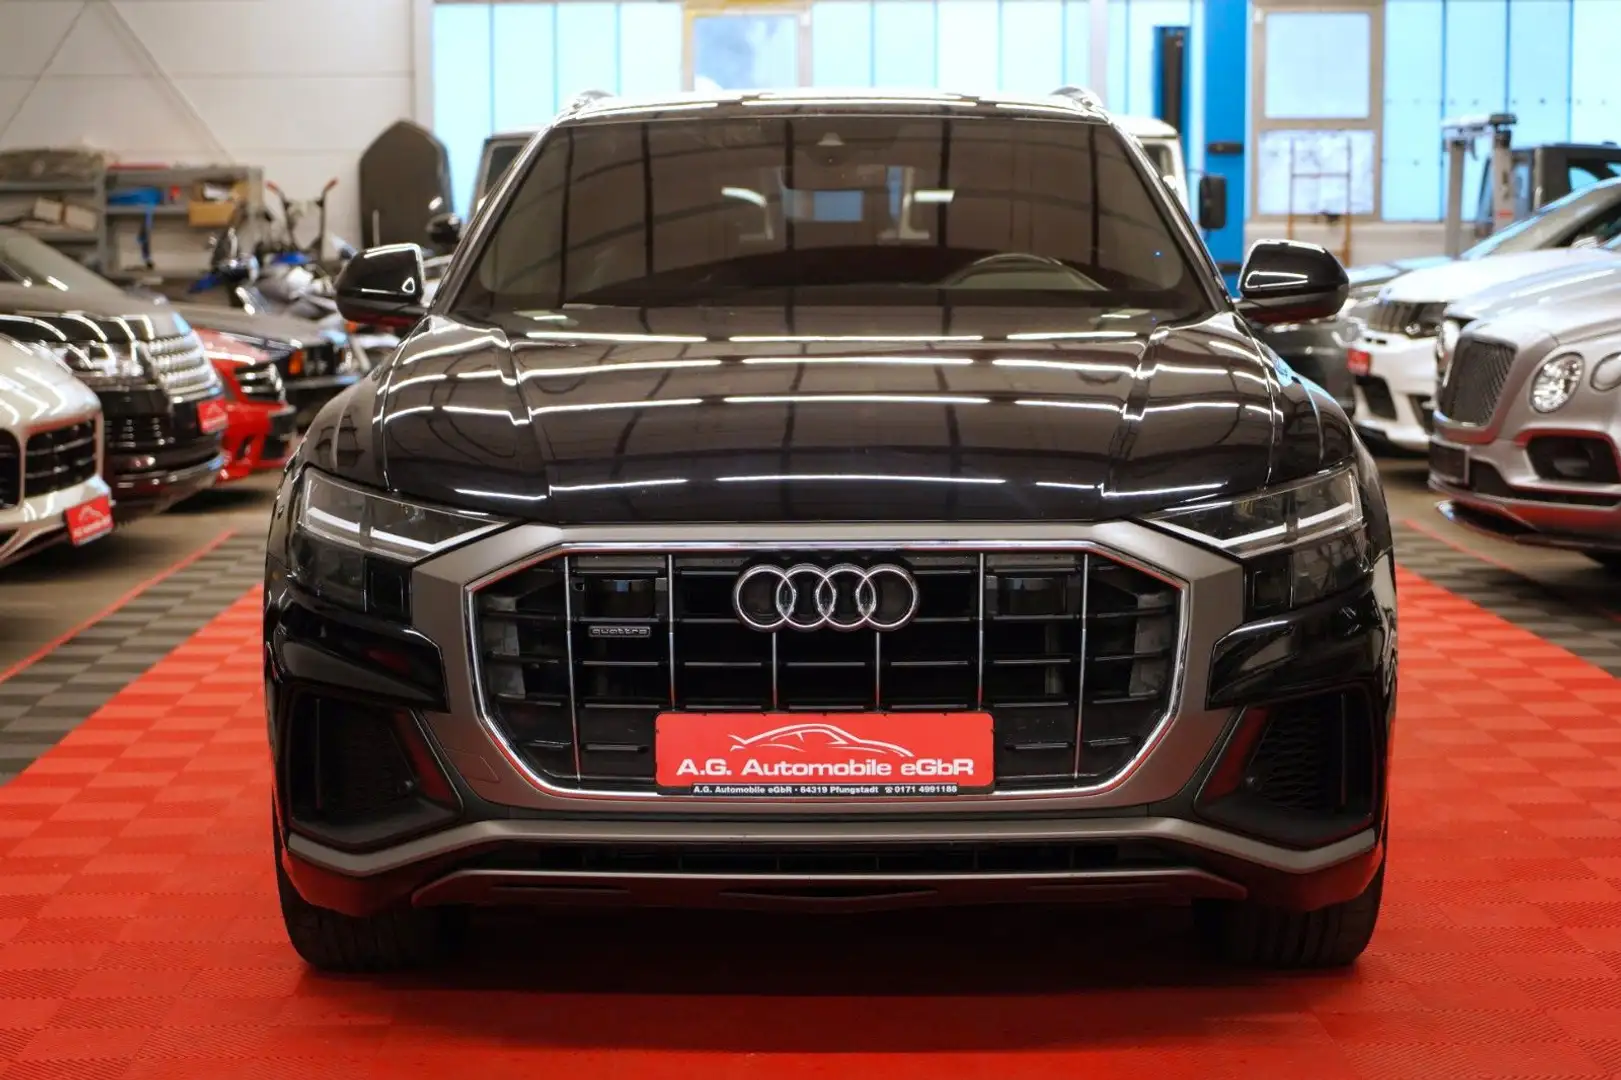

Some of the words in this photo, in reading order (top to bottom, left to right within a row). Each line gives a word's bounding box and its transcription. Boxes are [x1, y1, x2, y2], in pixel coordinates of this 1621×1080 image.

[591, 628, 648, 636] quattro
[676, 758, 732, 776] A.G.
[741, 758, 892, 776] Automobile
[900, 758, 974, 776] eGbR
[693, 785, 713, 794] A.G.
[715, 785, 766, 794] Automobile
[767, 785, 793, 794] eGbR
[800, 785, 828, 794] 64319
[829, 785, 879, 795] Pfungstadt
[894, 785, 917, 794] 0171
[918, 785, 958, 794] 4991188
